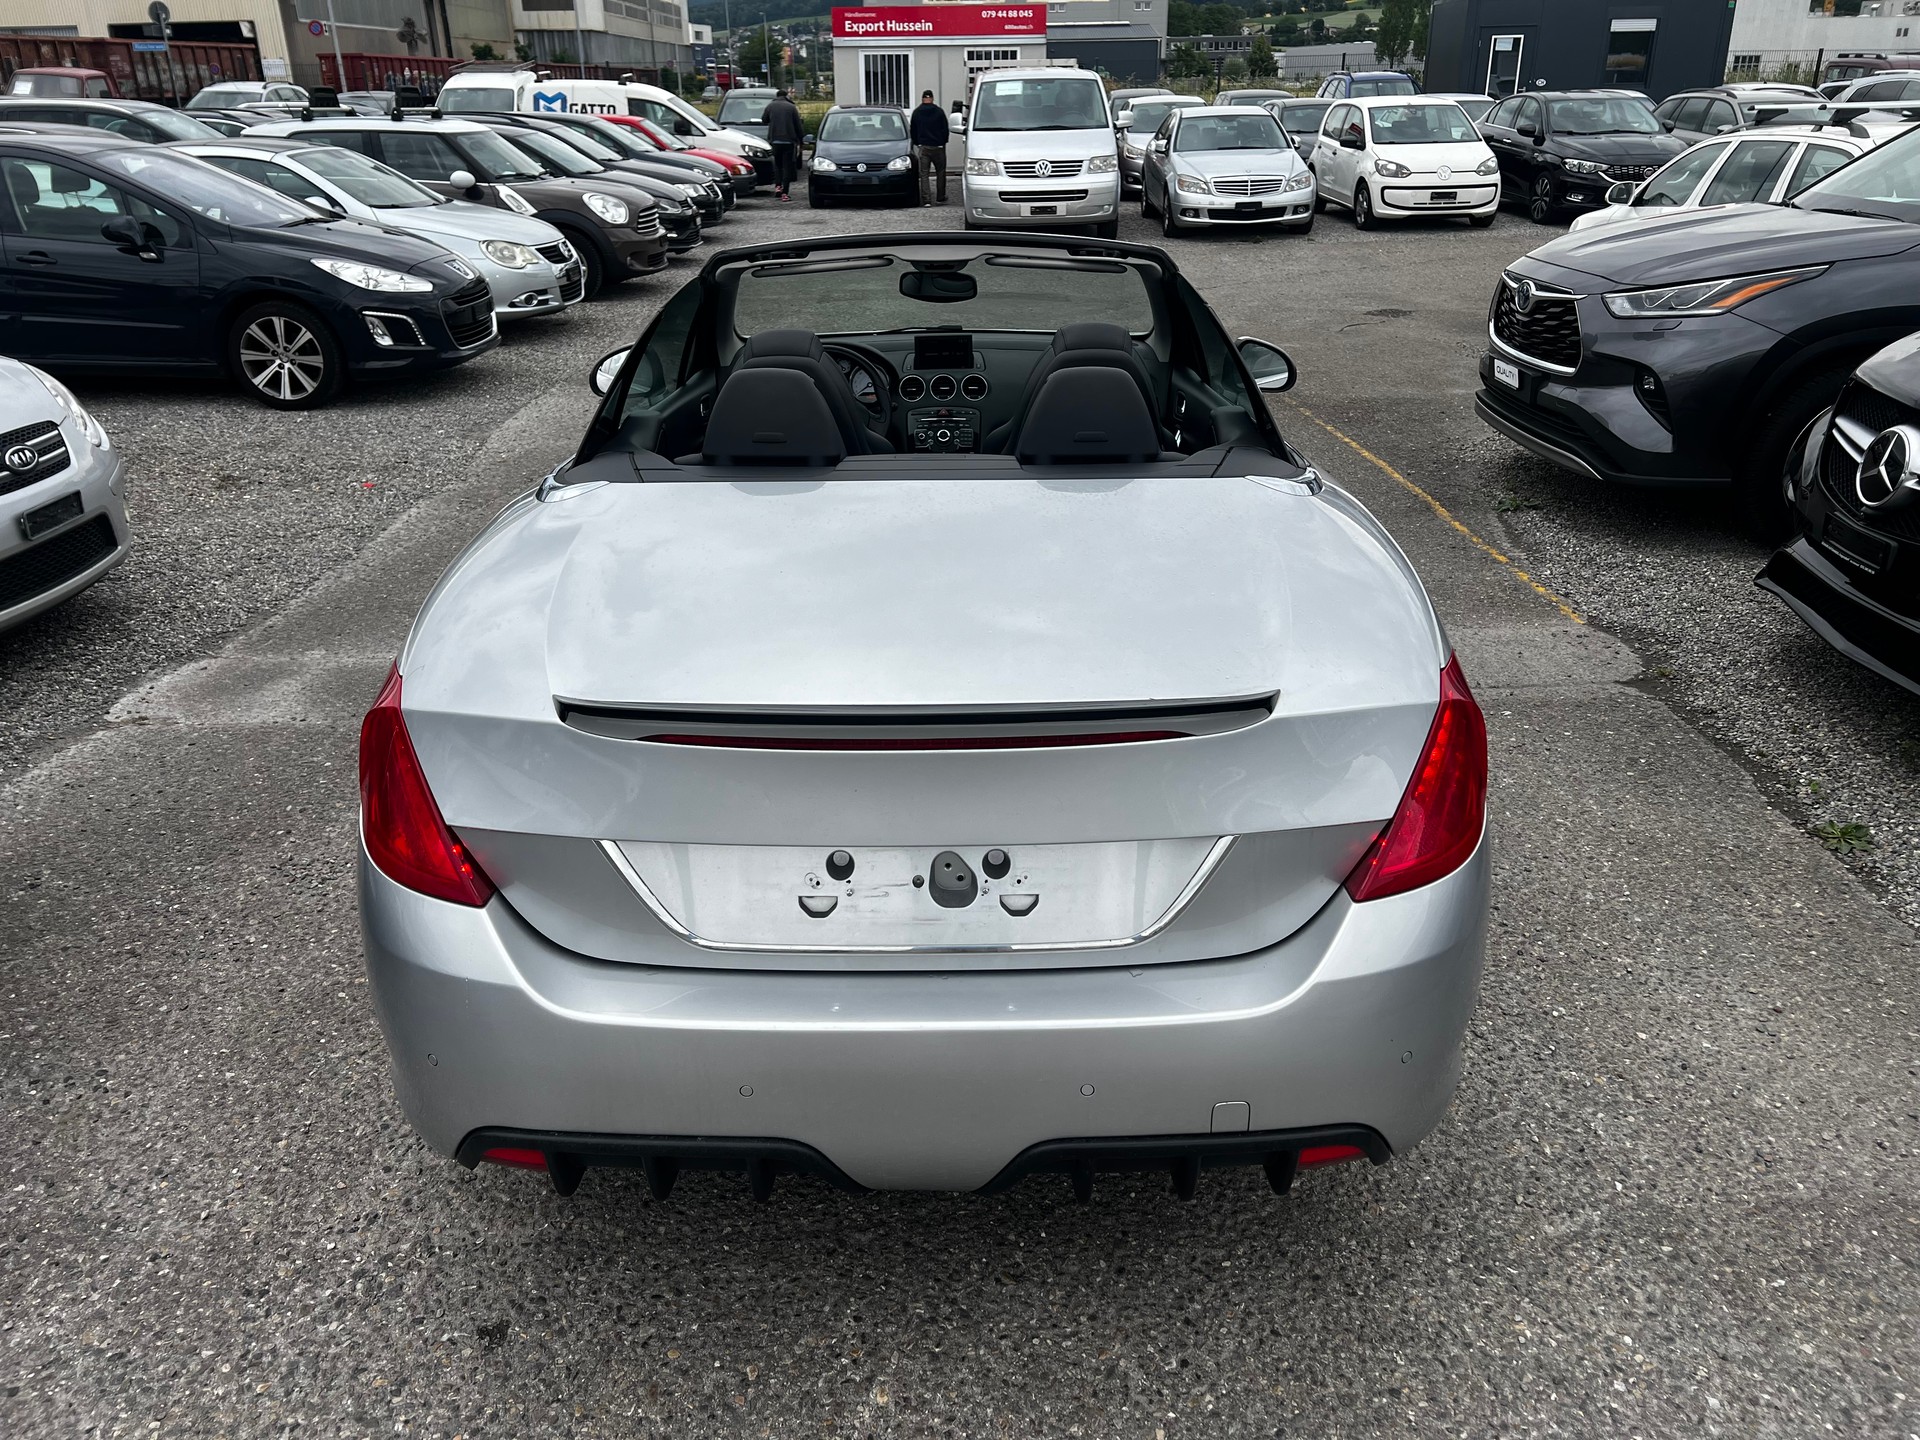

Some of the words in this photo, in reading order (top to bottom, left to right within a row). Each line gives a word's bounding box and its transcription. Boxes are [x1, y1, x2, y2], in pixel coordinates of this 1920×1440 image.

[981, 10, 996, 18] 079
[997, 10, 1007, 18] 44
[1007, 10, 1018, 18] 88
[1018, 10, 1033, 18] 045
[845, 20, 885, 35] Export
[886, 19, 933, 32] Hussein
[569, 103, 617, 114] GATTO
[10, 449, 35, 467] KIA
